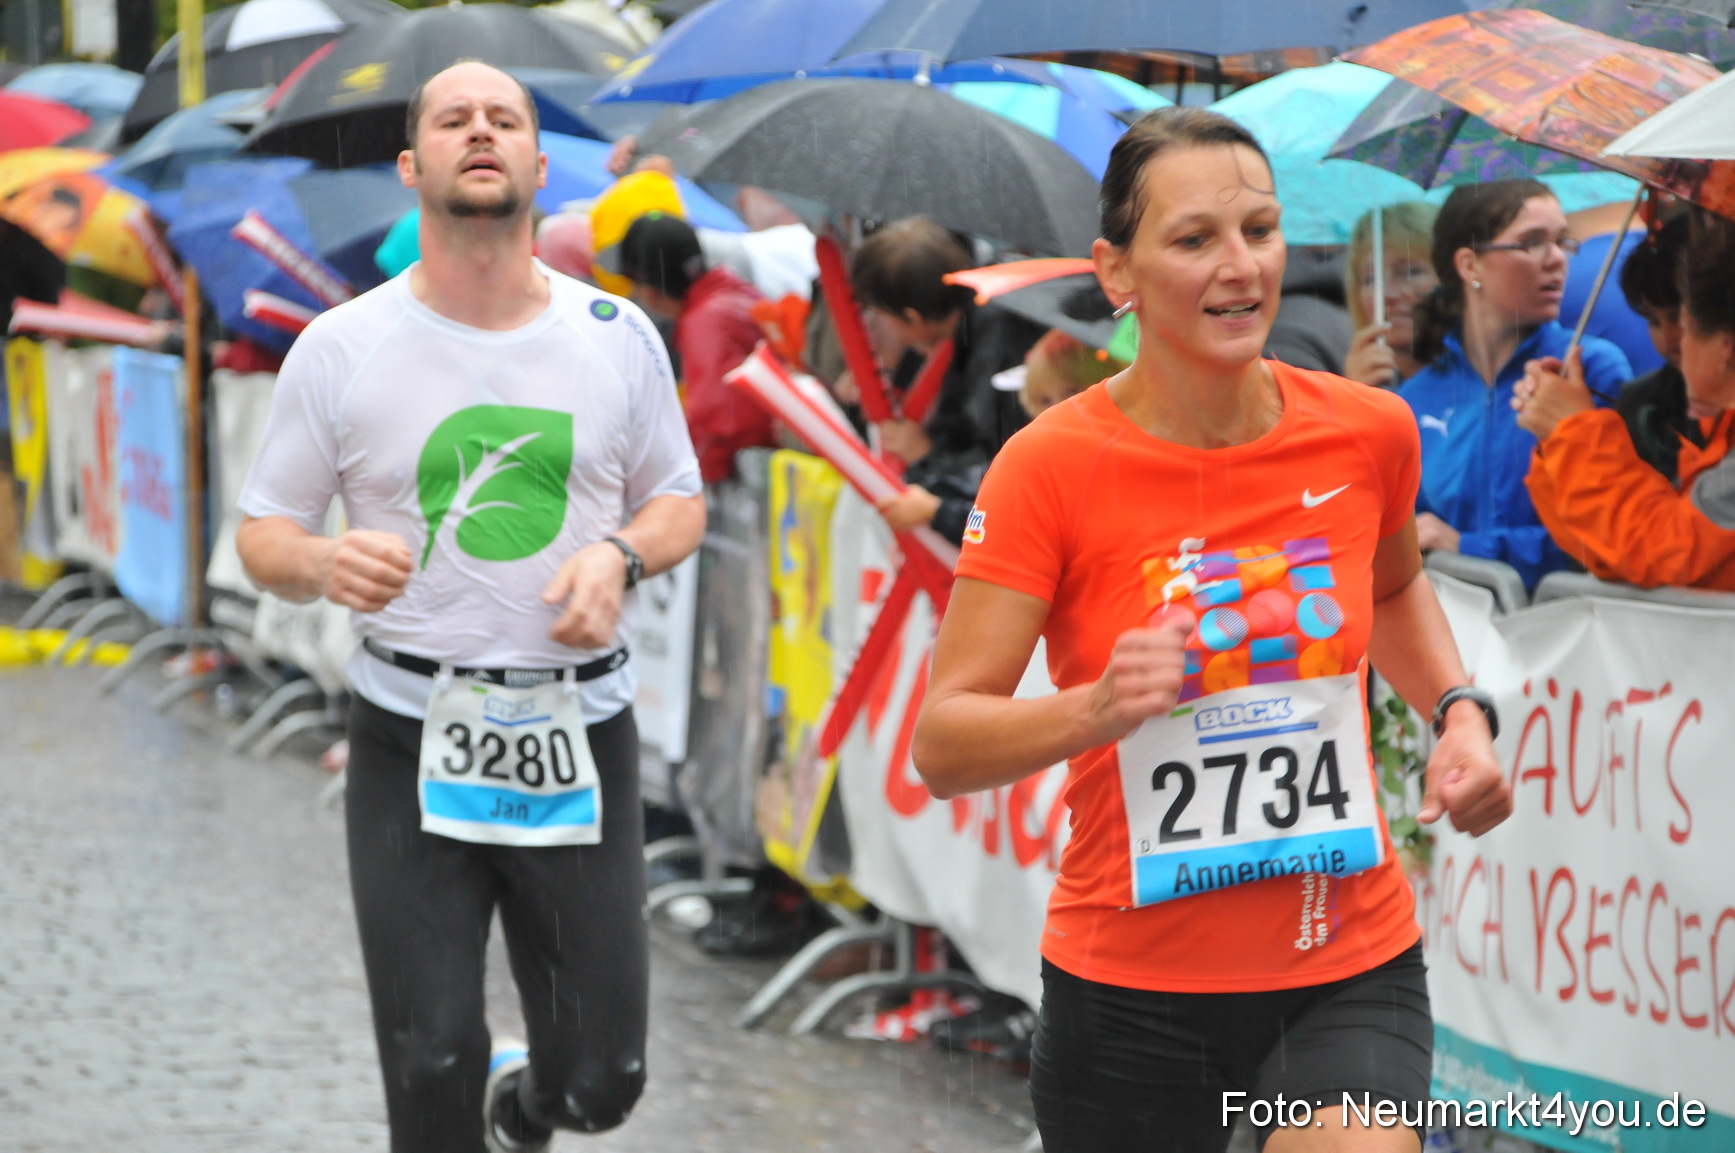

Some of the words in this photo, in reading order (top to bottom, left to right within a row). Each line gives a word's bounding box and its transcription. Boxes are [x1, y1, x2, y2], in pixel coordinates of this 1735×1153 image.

[1194, 696, 1294, 732] BOCK
[442, 723, 577, 787] 3280
[489, 797, 529, 821] Jan
[1151, 739, 1351, 844] 2734
[1174, 845, 1346, 894] Annemarie
[1314, 922, 1328, 947] dm
[1529, 867, 1735, 1040] BESSER
